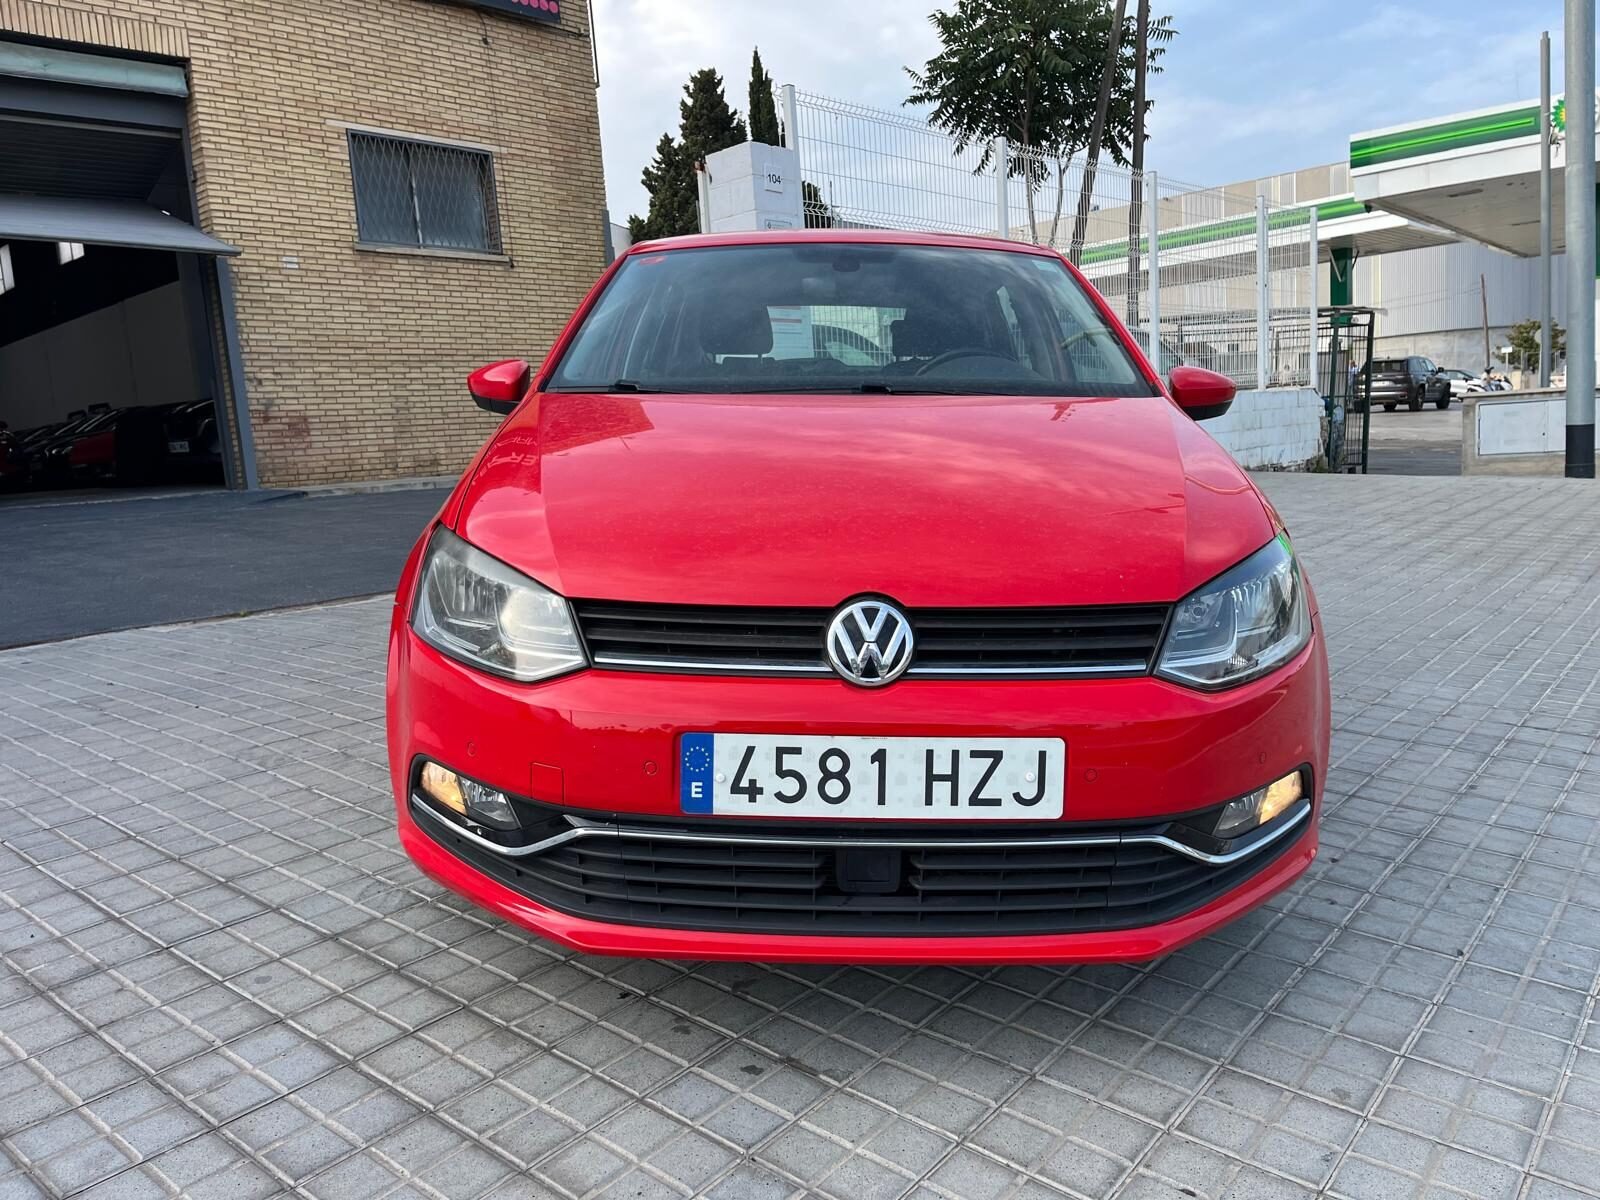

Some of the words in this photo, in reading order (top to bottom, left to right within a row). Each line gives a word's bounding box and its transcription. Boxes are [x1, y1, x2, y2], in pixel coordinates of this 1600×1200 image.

[767, 173, 782, 184] 104
[828, 602, 912, 684] VW
[691, 781, 703, 798] E
[730, 745, 887, 806] 4581
[924, 748, 1047, 807] HZJ
